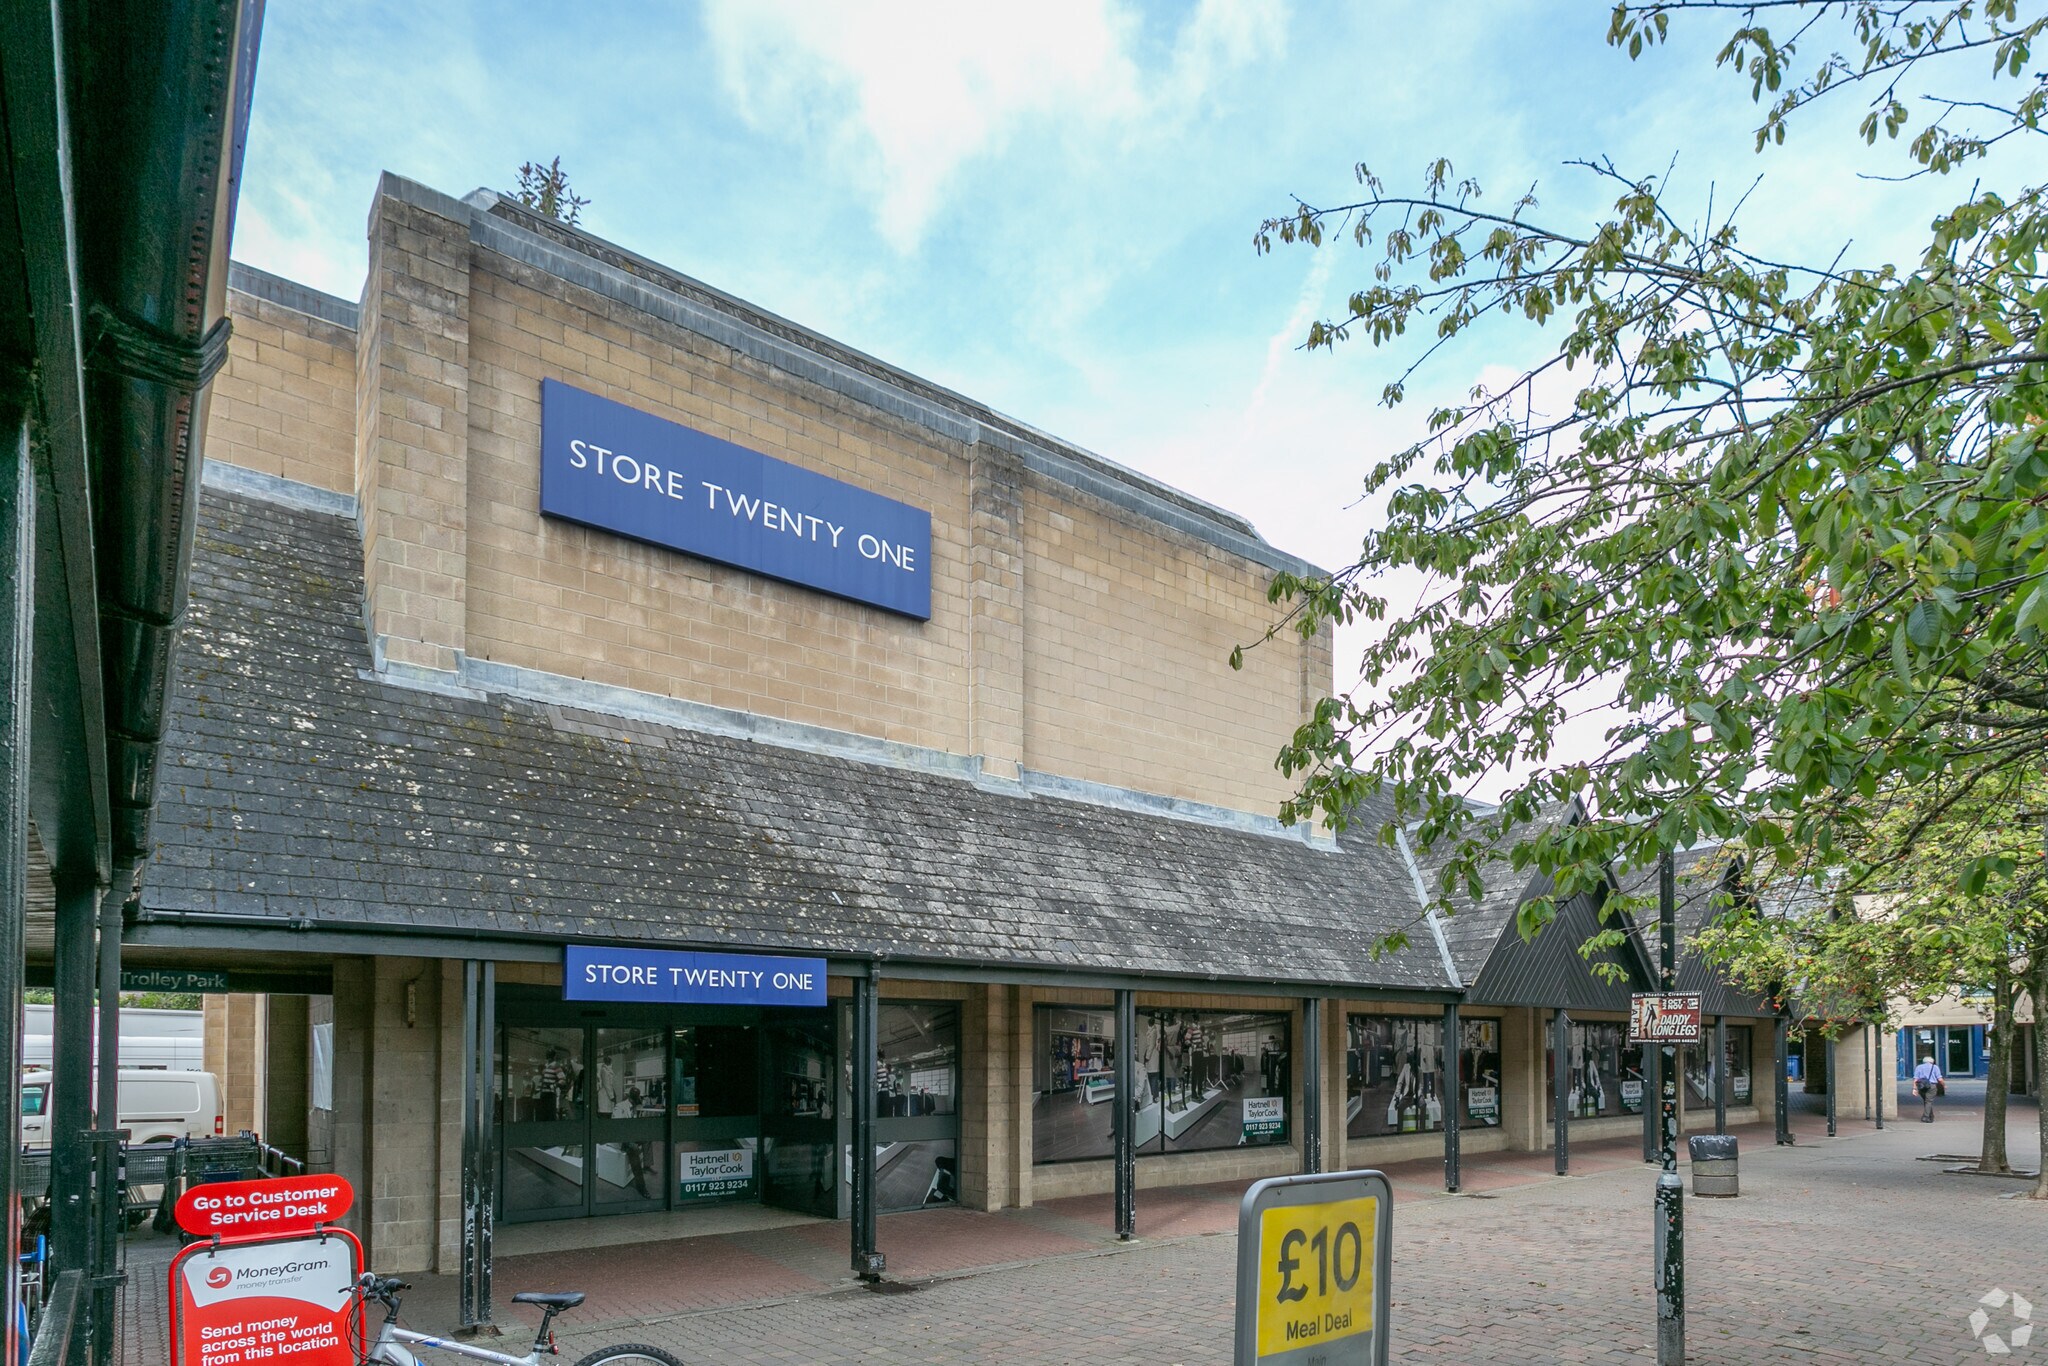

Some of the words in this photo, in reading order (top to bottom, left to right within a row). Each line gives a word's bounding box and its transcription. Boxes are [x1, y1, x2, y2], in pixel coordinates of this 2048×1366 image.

[569, 439, 684, 500] STORE
[702, 481, 844, 548] TWENTY
[858, 534, 915, 572] ONE
[120, 972, 182, 989] Trolley
[187, 974, 224, 988] Park
[585, 964, 657, 985] STORE
[669, 967, 764, 988] TWENTY
[772, 972, 813, 991] ONE
[1652, 1025, 1675, 1036] LONG
[1675, 1025, 1698, 1036] LEGS
[1660, 1014, 1691, 1025] DADDY
[1248, 1110, 1263, 1118] Taylor
[1265, 1109, 1278, 1117] Cook
[690, 1153, 729, 1164] Hartnell
[689, 1163, 719, 1177] Taylor
[720, 1163, 743, 1174] Cook
[685, 1183, 706, 1192] 0117
[709, 1181, 725, 1190] 923
[727, 1180, 748, 1189] 9234
[193, 1197, 221, 1210] Go
[224, 1195, 245, 1207] to
[249, 1186, 339, 1205] Customer
[210, 1209, 281, 1225] Service
[284, 1202, 328, 1218] Desk
[236, 1259, 329, 1280] MoneyGram
[1276, 1221, 1362, 1304] £10
[236, 1279, 267, 1290] money
[269, 1275, 303, 1285] transfer
[201, 1322, 243, 1339] Send
[247, 1315, 298, 1333] money
[1286, 1315, 1320, 1342] Meal
[1325, 1308, 1352, 1333] Deal
[201, 1336, 256, 1354] across
[261, 1330, 286, 1344] the
[290, 1321, 333, 1338] world
[201, 1352, 240, 1366] from
[245, 1345, 274, 1361] this
[278, 1336, 339, 1355] location
